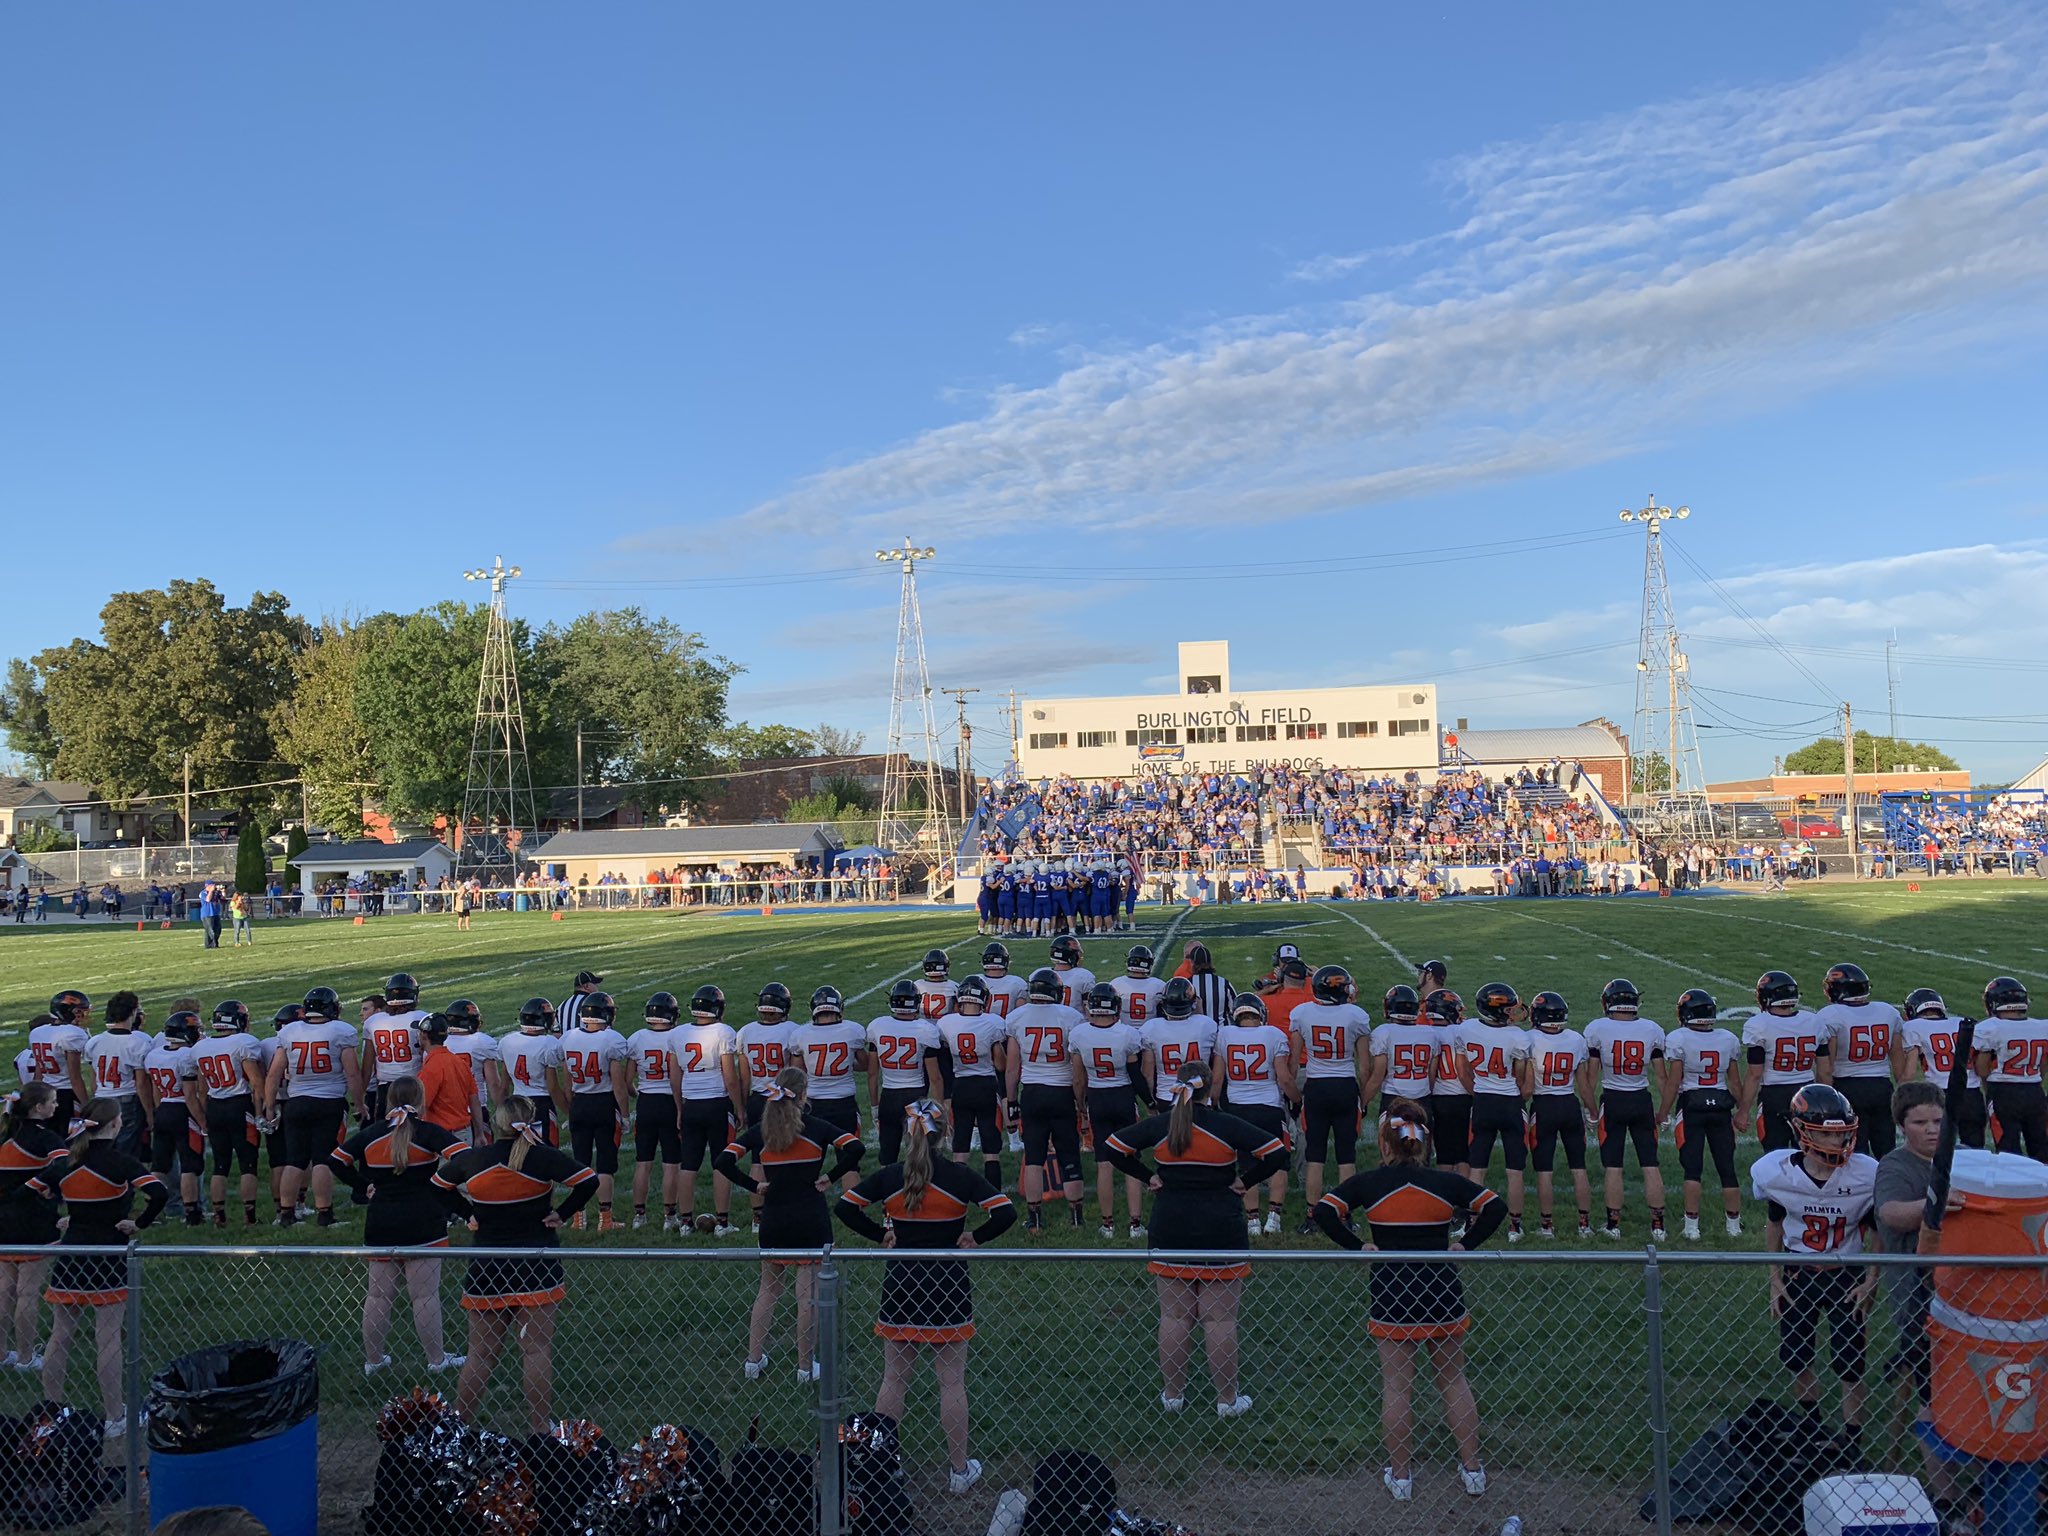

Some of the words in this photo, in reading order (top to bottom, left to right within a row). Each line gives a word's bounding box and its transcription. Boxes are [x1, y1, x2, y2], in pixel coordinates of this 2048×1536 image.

[1137, 710, 1249, 728] BURLINGTON
[1262, 707, 1312, 724] FIELD
[1132, 762, 1172, 775] HOME
[1182, 761, 1201, 774] OF
[1209, 760, 1236, 773] THE
[922, 993, 947, 1019] 12
[1129, 992, 1146, 1020] 6
[291, 1041, 332, 1075] 76
[374, 1029, 412, 1063] 88
[685, 1043, 705, 1073] 2
[808, 1042, 849, 1077] 72
[879, 1035, 919, 1070] 22
[957, 1033, 978, 1065] 8
[1025, 1027, 1065, 1063] 73
[1311, 1025, 1345, 1060] 51
[1612, 1040, 1645, 1076] 18
[1773, 1035, 1816, 1072] 66
[1848, 1024, 1890, 1063] 68
[1930, 1032, 1958, 1073] 8
[2002, 1039, 2048, 1076] 20
[97, 1055, 121, 1089] 14
[198, 1054, 237, 1089] 80
[514, 1054, 531, 1086] 4
[566, 1051, 602, 1084] 34
[747, 1043, 785, 1078] 39
[1092, 1047, 1115, 1079] 5
[1226, 1043, 1269, 1081] 62
[1393, 1044, 1431, 1080] 59
[1466, 1042, 1508, 1079] 24
[1542, 1052, 1574, 1087] 19
[1698, 1051, 1720, 1086] 3
[1804, 1205, 1842, 1215] PALMYRA
[1802, 1215, 1847, 1253] 81
[1995, 1363, 2033, 1400] G
